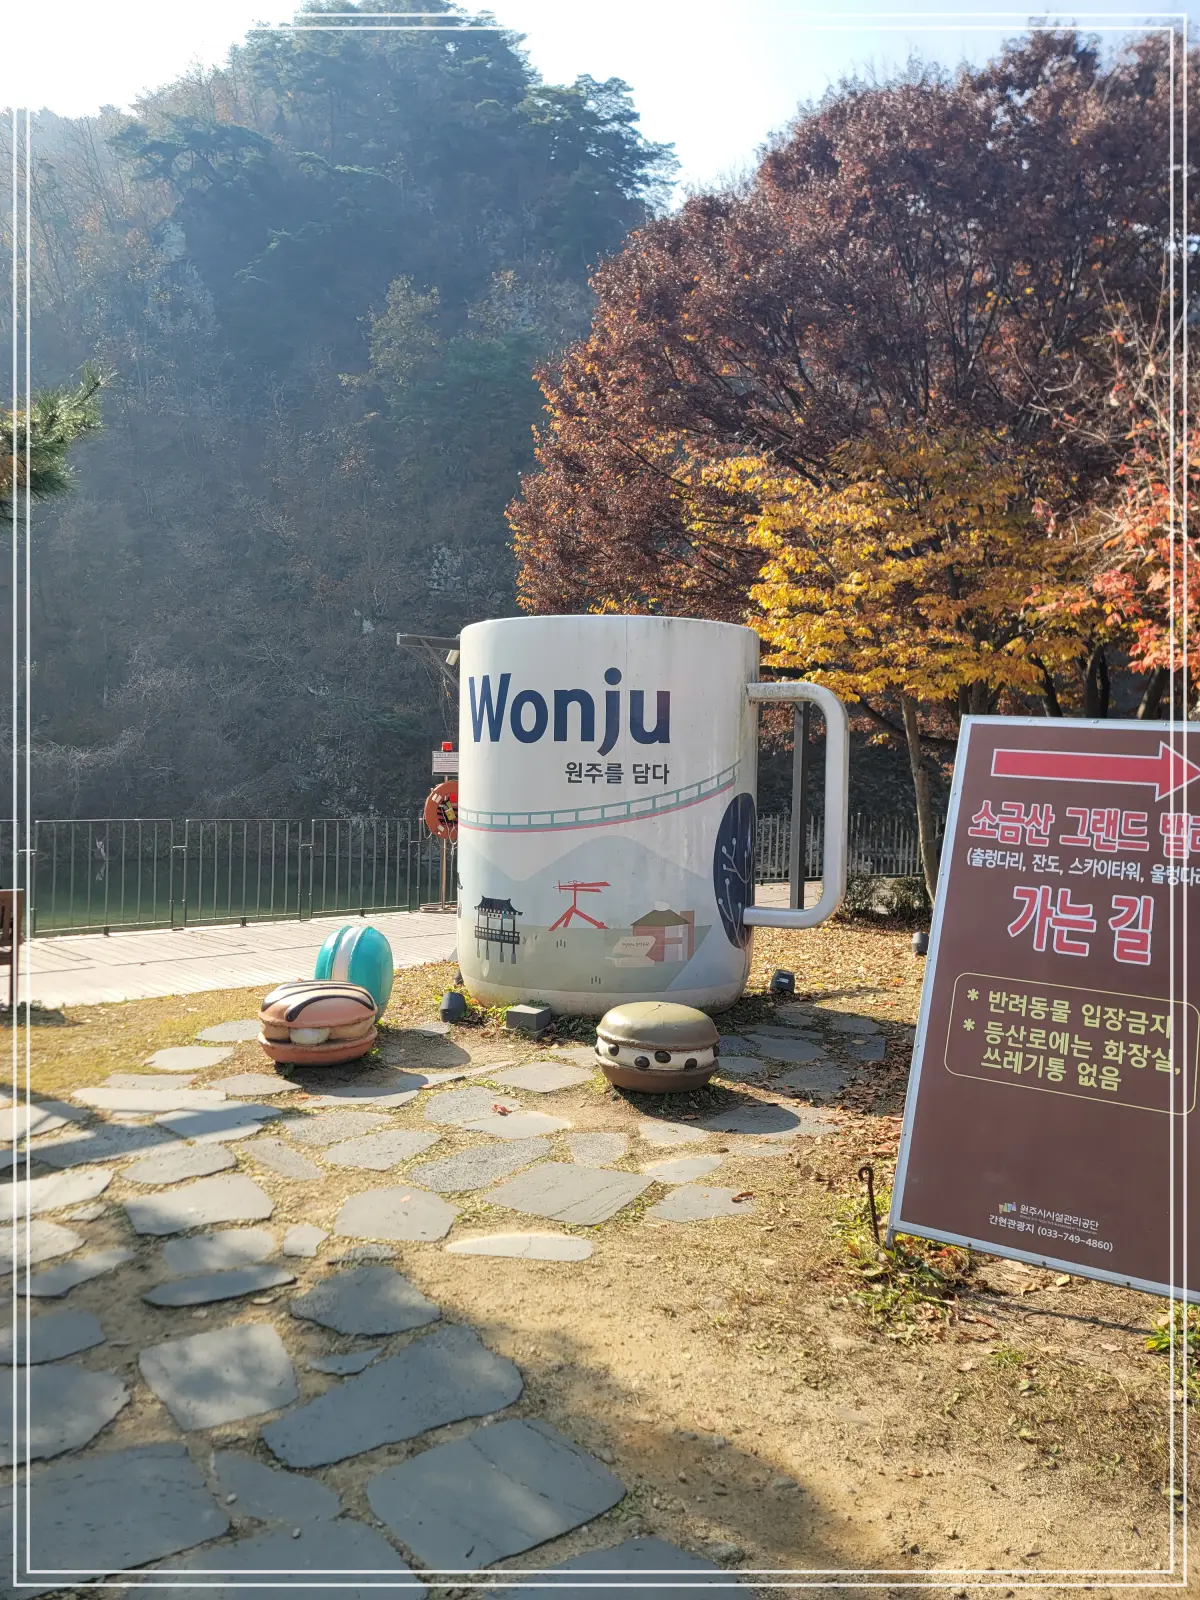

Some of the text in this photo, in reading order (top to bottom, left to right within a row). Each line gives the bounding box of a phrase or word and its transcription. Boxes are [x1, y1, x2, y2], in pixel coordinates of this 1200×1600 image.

[469, 667, 670, 756] Wonju
[564, 761, 670, 785] 원주를 담다
[968, 800, 1055, 847] 소금산
[1059, 806, 1150, 853] 그랜드
[967, 847, 1200, 887] (출렁다리, 잔도, 스카이타워, 울렁다
[1007, 885, 1155, 966] 가는 길
[988, 990, 1172, 1039] 반려동물 입장금지
[981, 1047, 1122, 1092] 쓰레기통 없음
[984, 1021, 1181, 1075] 등산로에는 화장실,
[989, 1214, 1035, 1234] 간현관광지
[1037, 1226, 1113, 1252] (033-749-4860)
[1020, 1204, 1099, 1231] 원주시시설관리공단
